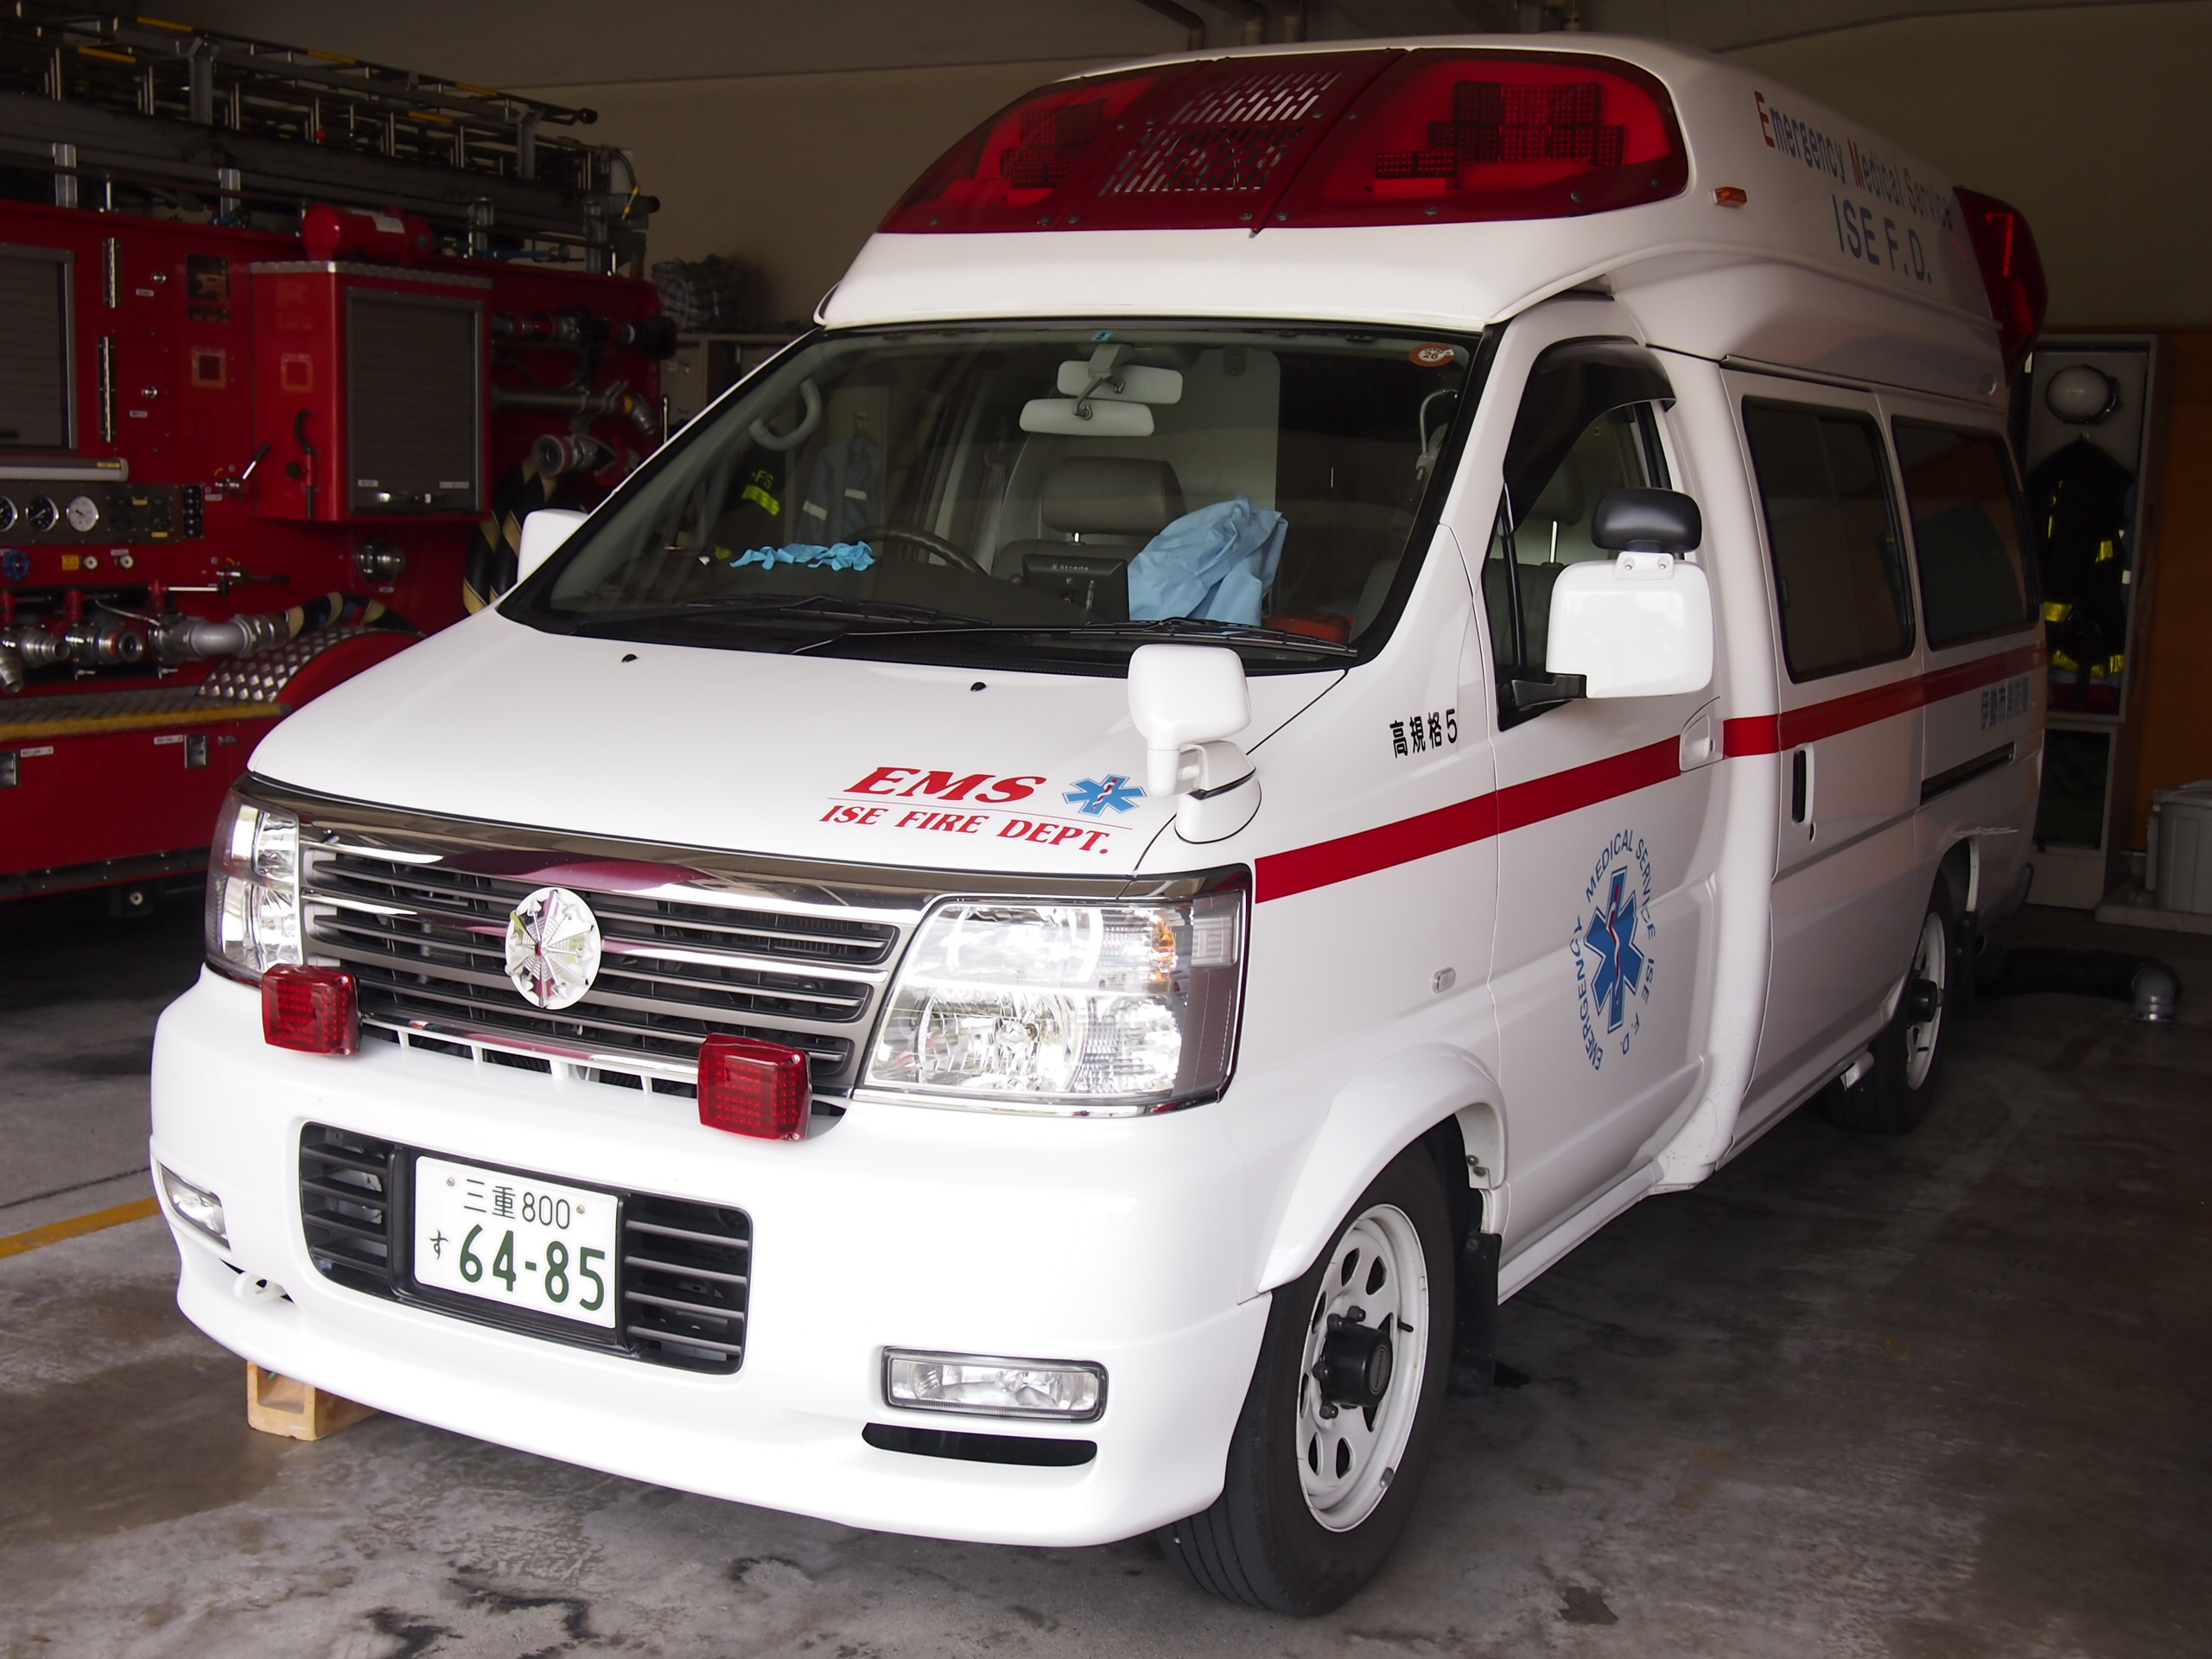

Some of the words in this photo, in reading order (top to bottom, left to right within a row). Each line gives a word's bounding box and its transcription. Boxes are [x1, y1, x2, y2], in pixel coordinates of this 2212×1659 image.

[1753, 90, 1846, 184] Emergency
[1847, 137, 1904, 207] Medical
[1832, 194, 1880, 265] ISE
[842, 766, 1047, 804] EMS
[818, 804, 889, 825] ISE
[893, 810, 990, 835] FIRE
[995, 818, 1111, 855] DEPT.
[1586, 829, 1634, 903] MEDICAL
[1636, 837, 1656, 941] SERVICE
[1569, 915, 1604, 1071] EMERGENCY
[1641, 957, 1656, 1005] ISE
[429, 1228, 450, 1261] す
[459, 1223, 606, 1312] 64-85
